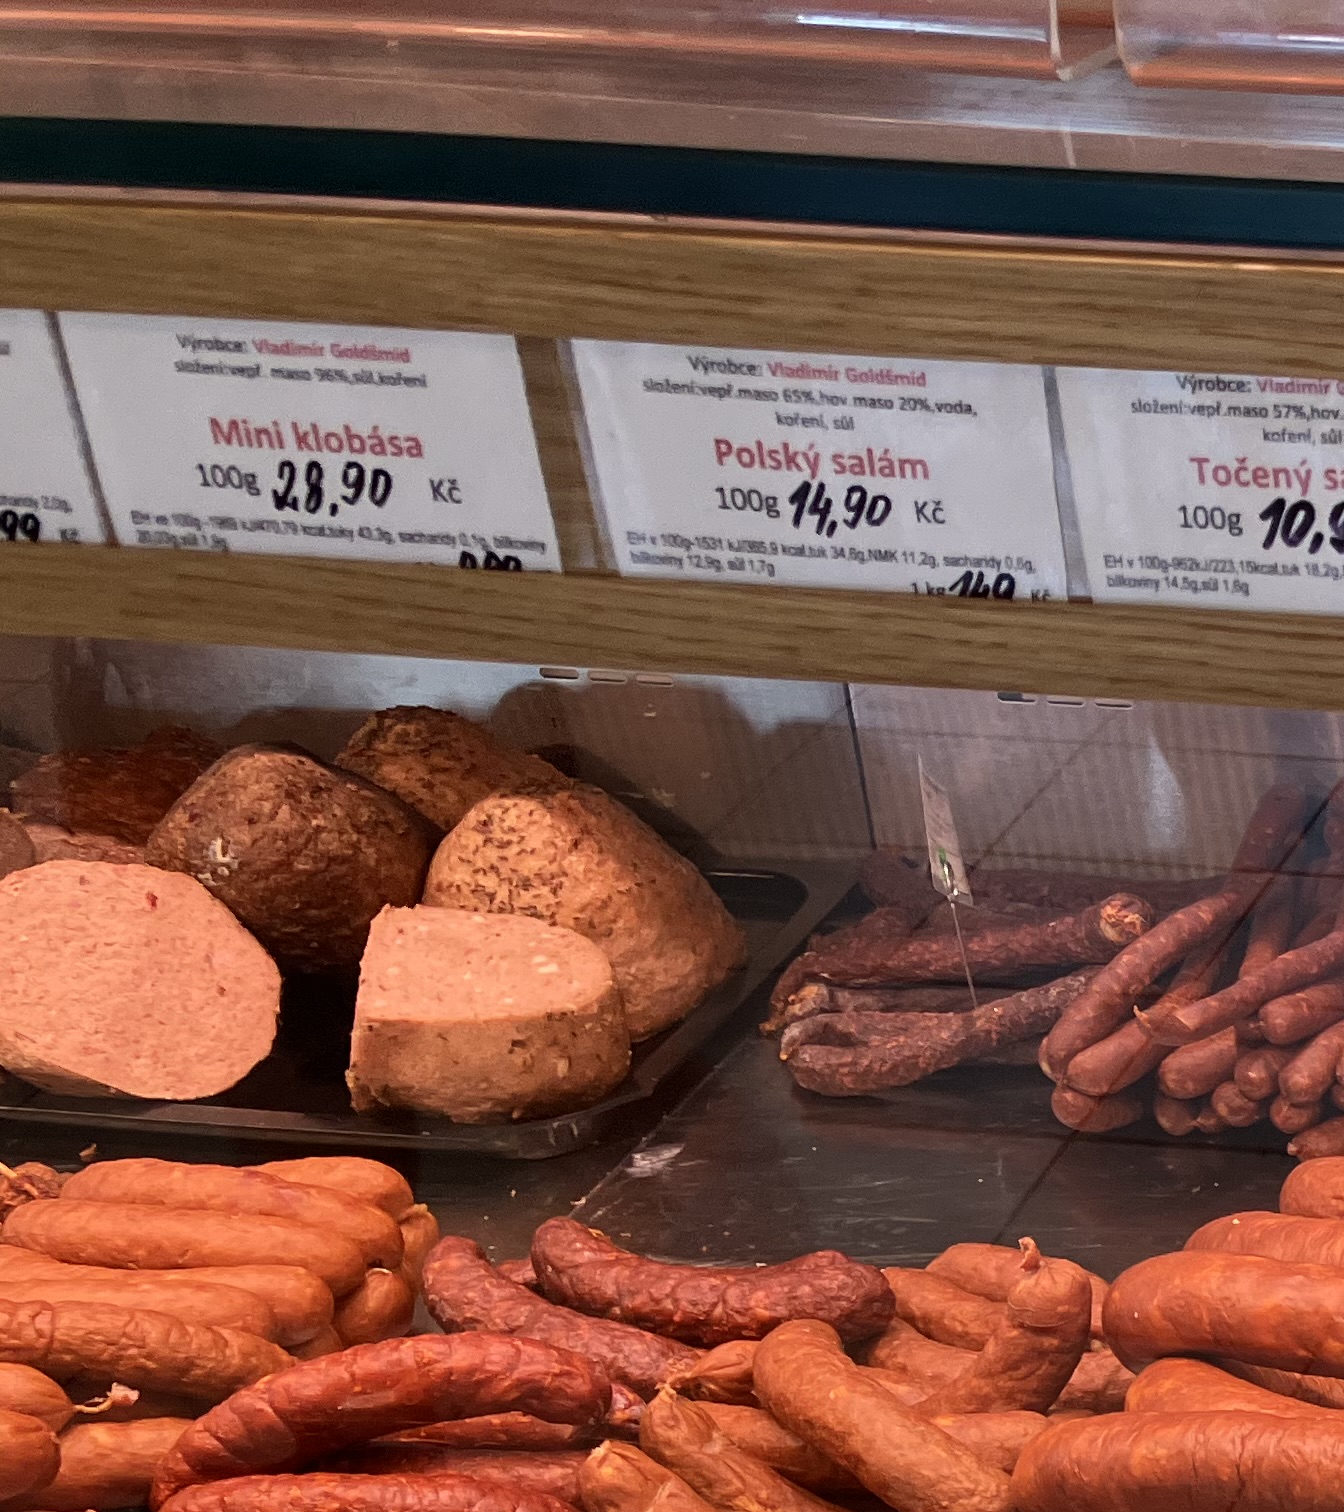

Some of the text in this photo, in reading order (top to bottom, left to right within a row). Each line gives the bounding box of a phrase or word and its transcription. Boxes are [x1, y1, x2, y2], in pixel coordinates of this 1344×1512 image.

[208, 416, 425, 459] Mini klobása
[714, 438, 930, 480] Polský salám
[1189, 456, 1313, 496] Točený
[196, 459, 462, 517] 100g 28,90 Kč
[715, 480, 946, 539] 100g 14,90 Kč
[1177, 504, 1244, 536] 100g
